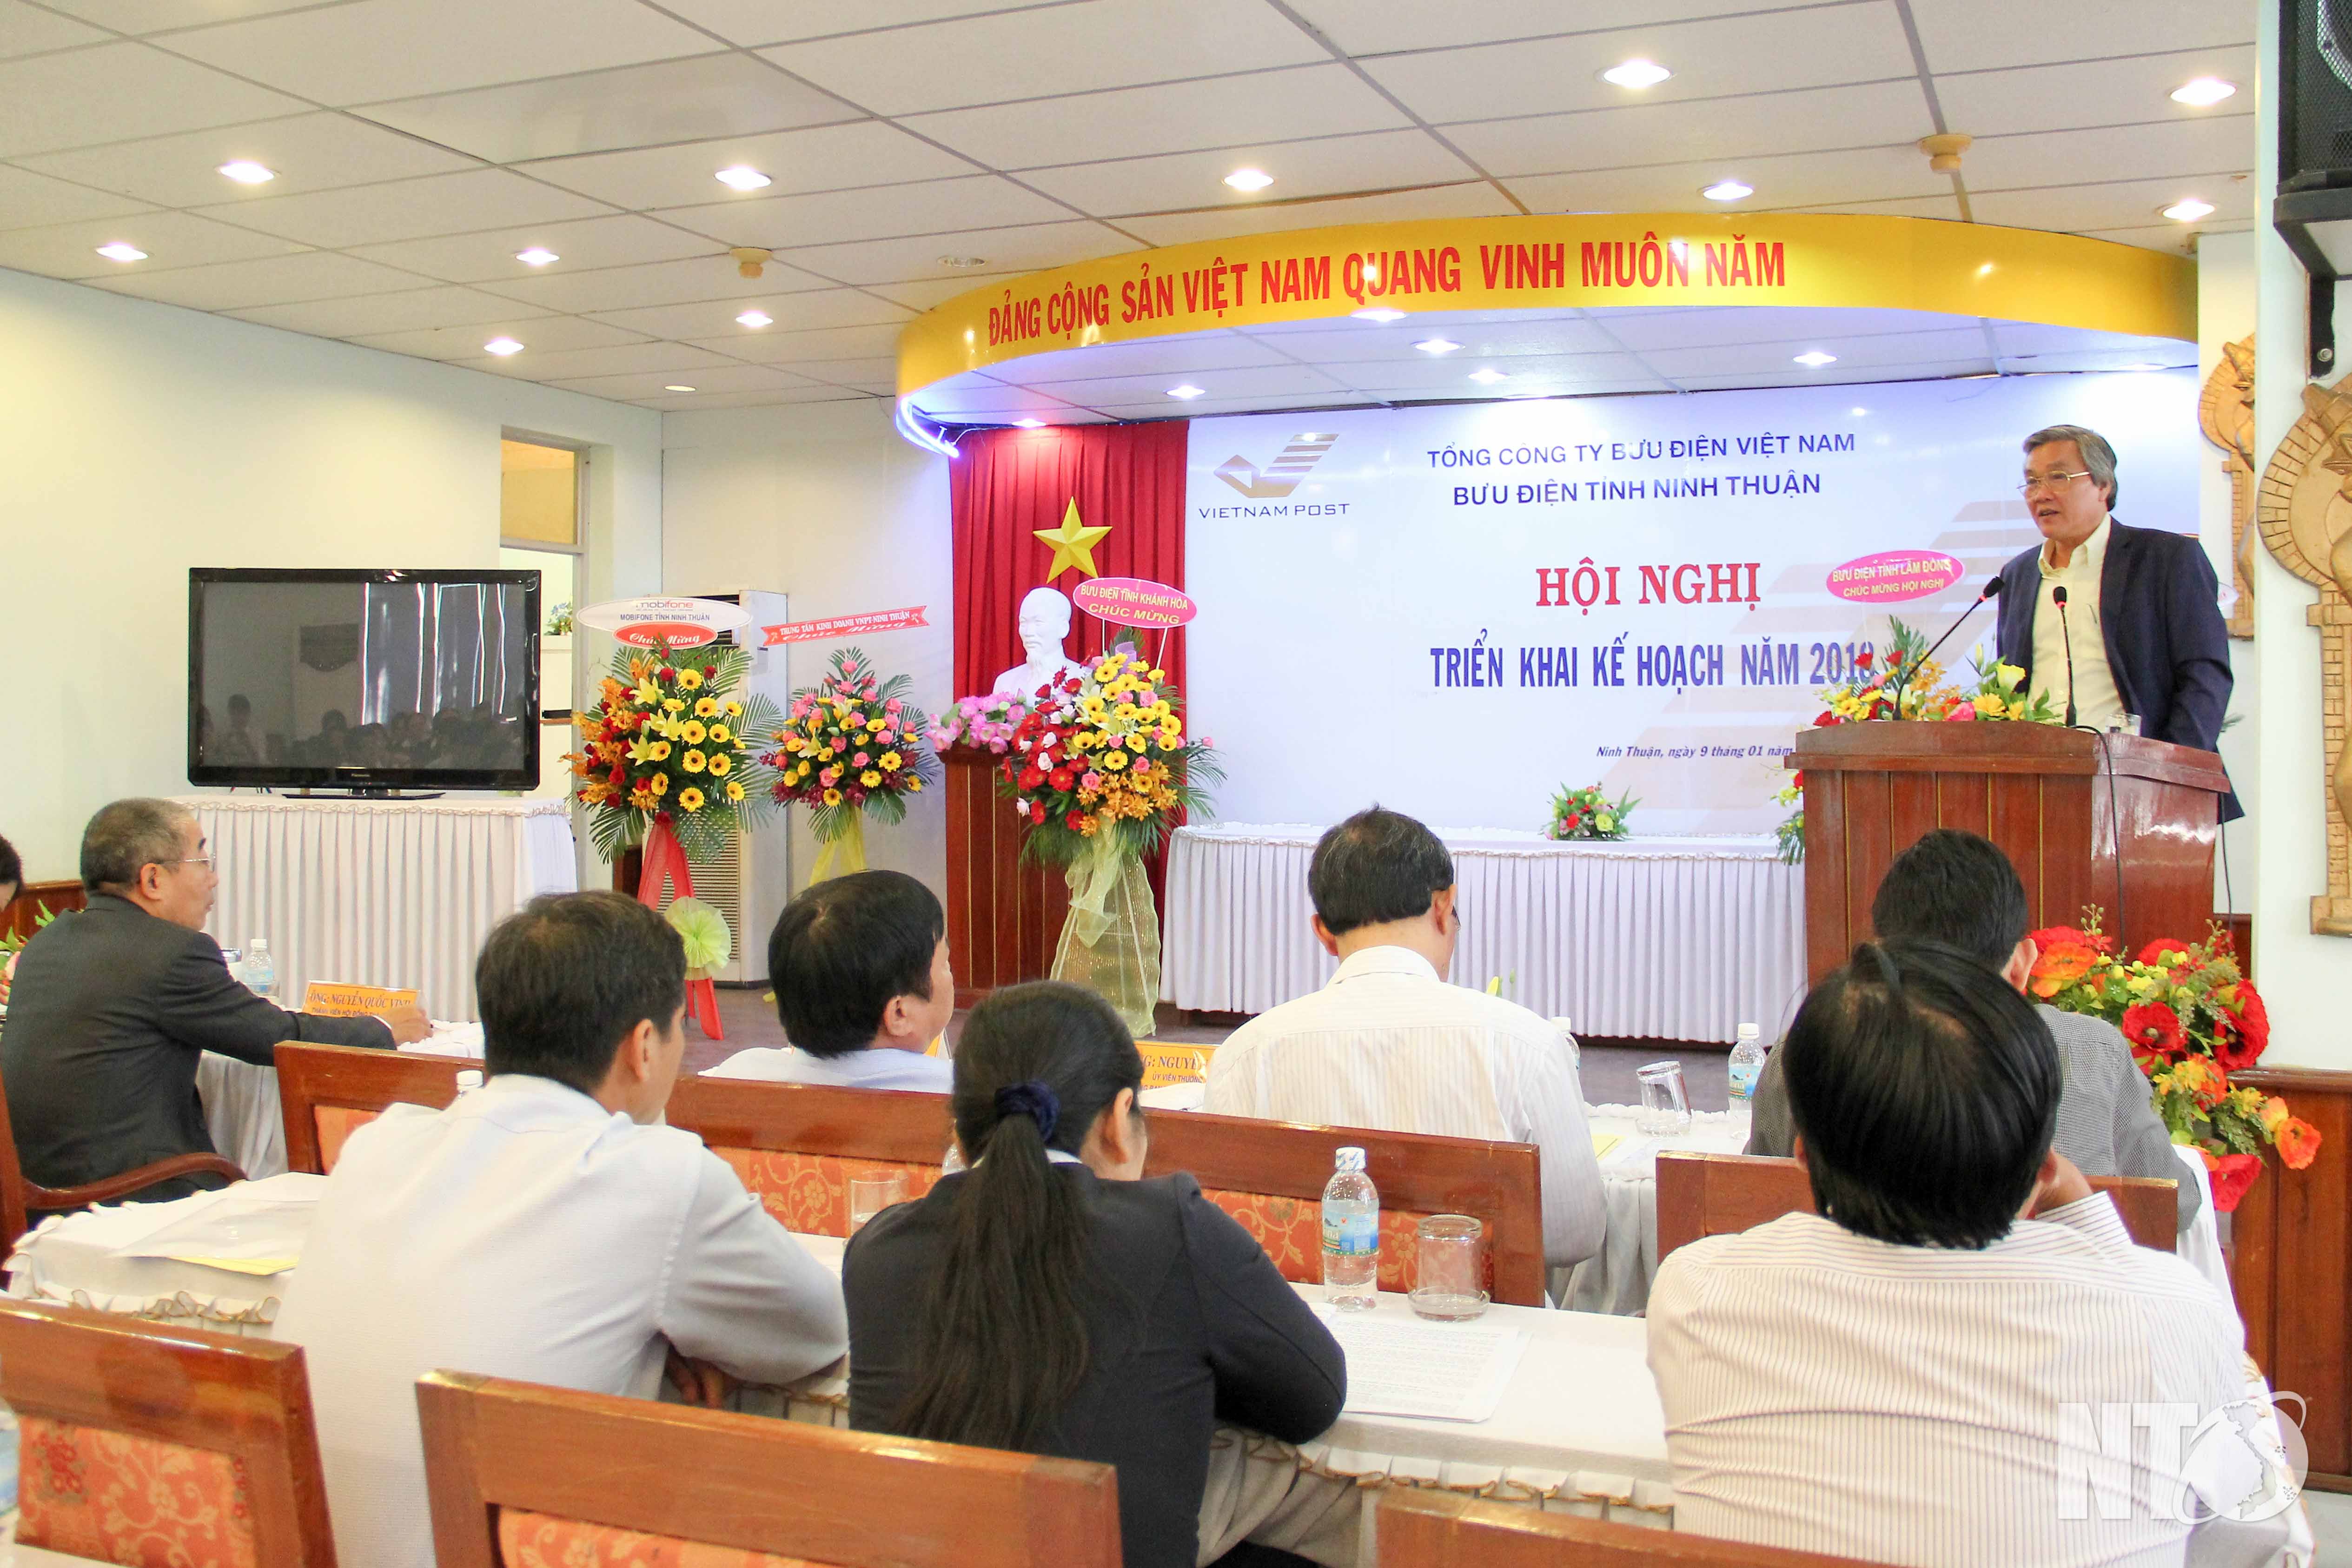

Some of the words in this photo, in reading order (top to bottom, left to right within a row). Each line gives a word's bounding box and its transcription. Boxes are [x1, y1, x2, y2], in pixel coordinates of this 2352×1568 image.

[989, 290, 1040, 346] ĐẢNG
[1048, 282, 1109, 340] CỘNG
[1121, 264, 1173, 323] SẢN
[1182, 257, 1249, 318] VIỆT
[1261, 256, 1331, 304] NAM
[1343, 246, 1460, 305] QUANG
[1480, 243, 1564, 289] VINH
[1583, 232, 1689, 287] MUÔN
[1706, 234, 1784, 286] NĂM
[1428, 441, 1491, 468] TỔNG
[1499, 443, 1566, 465] CÔNG
[1574, 444, 1603, 462] TY
[1612, 438, 1662, 460] BƯU
[1670, 435, 1727, 461] ĐIỆN
[1737, 432, 1790, 459] VIỆT
[1798, 433, 1855, 453] NAM
[1453, 483, 1509, 506] BƯU
[1517, 478, 1577, 507] ĐIỆN
[1585, 476, 1645, 501] TỈNH
[1654, 477, 1718, 499] NINH
[1726, 469, 1821, 499] THUẬN
[1199, 505, 1288, 519] VIETNAM
[1295, 503, 1350, 516] POST
[1833, 568, 1853, 582] BƯU
[1854, 565, 1875, 582] ĐIỆN
[1900, 560, 1921, 575] LÂM
[1080, 585, 1098, 597] BƯU
[1100, 587, 1119, 601] ĐIỆN
[1140, 593, 1168, 608] KHÁNH
[1170, 596, 1188, 610] HÒA
[1536, 556, 1622, 615] HỘI
[1638, 562, 1761, 611] NGHỊ
[1843, 585, 1869, 597] CHÚC
[1871, 582, 1900, 595] MỪNG
[1901, 580, 1919, 593] HỘI
[1088, 603, 1131, 617] CHÚC
[1133, 609, 1179, 624] MỪNG
[1431, 629, 1503, 688] TRIỂN
[1520, 647, 1578, 687] KHAI
[1593, 631, 1629, 687] KẾ
[1637, 643, 1723, 694] HOẠCH
[1741, 636, 1799, 685] NĂM
[1596, 746, 1622, 757] Ninh
[1626, 746, 1663, 759] Thuận,
[1668, 746, 1696, 759] ngày
[1700, 746, 1708, 757] 9
[1711, 746, 1744, 759] tháng
[1748, 746, 1763, 756] 01
